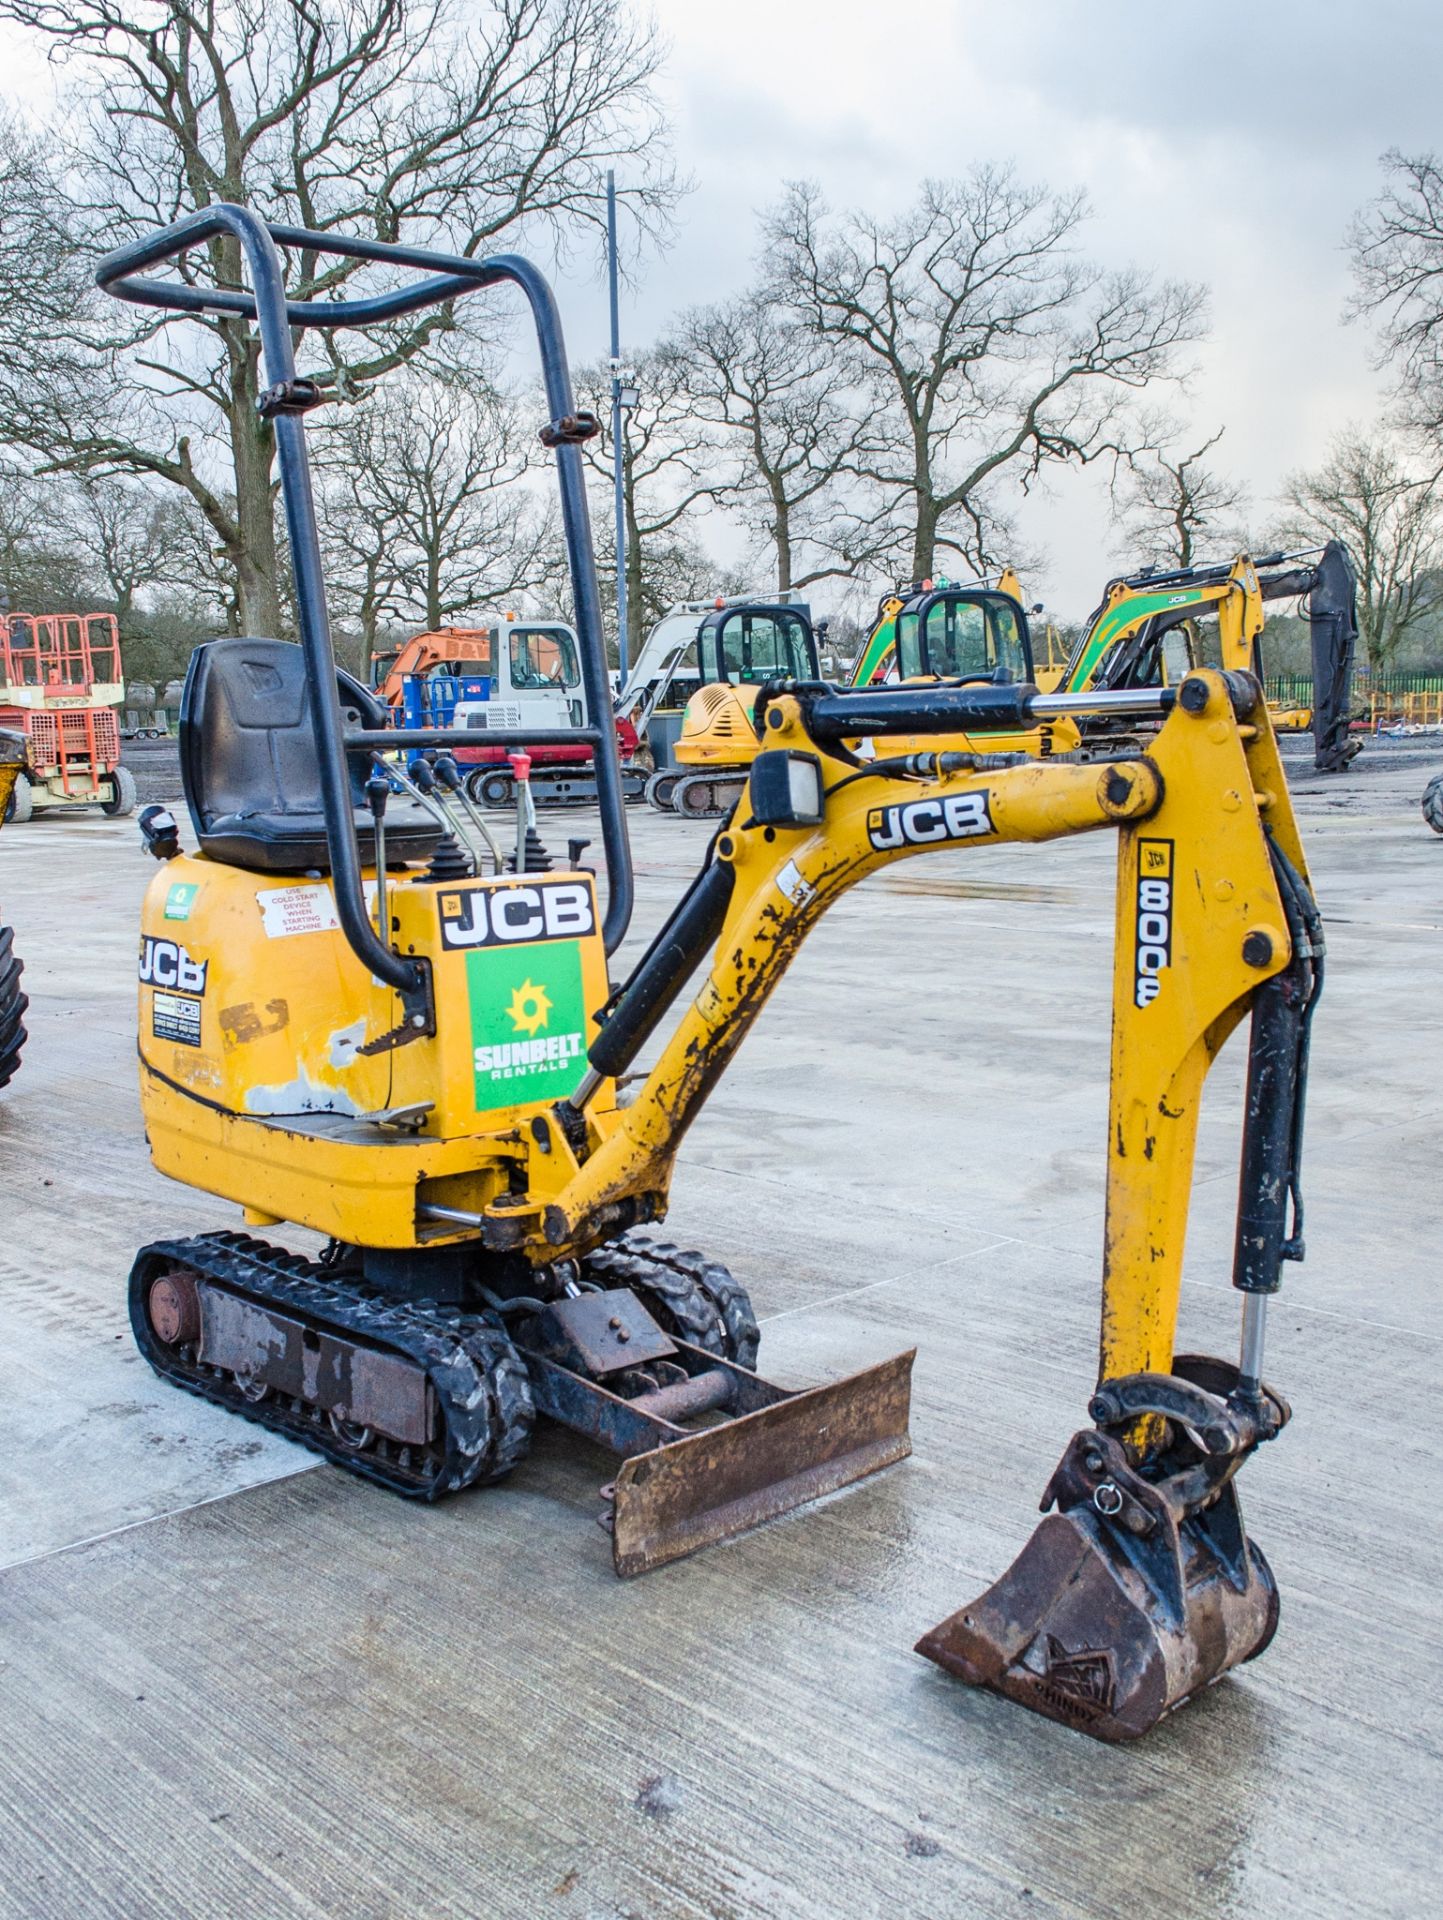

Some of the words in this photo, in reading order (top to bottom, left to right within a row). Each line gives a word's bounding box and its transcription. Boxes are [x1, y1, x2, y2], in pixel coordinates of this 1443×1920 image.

[1168, 595, 1187, 604] JCB
[870, 794, 991, 848] JCB
[1148, 851, 1165, 867] JCB
[272, 896, 294, 904] COLD
[295, 893, 318, 901] START
[283, 901, 311, 910] DEVICE
[282, 915, 321, 925] STARTING
[287, 909, 312, 917] WHEN
[445, 885, 592, 945] JCB
[286, 923, 321, 932] MACHINE
[1137, 880, 1169, 1008] 8008
[139, 940, 204, 992] JCB
[177, 1002, 198, 1017] JCB
[474, 1032, 582, 1071] SUNBELT
[491, 1059, 568, 1080] RENTALS
